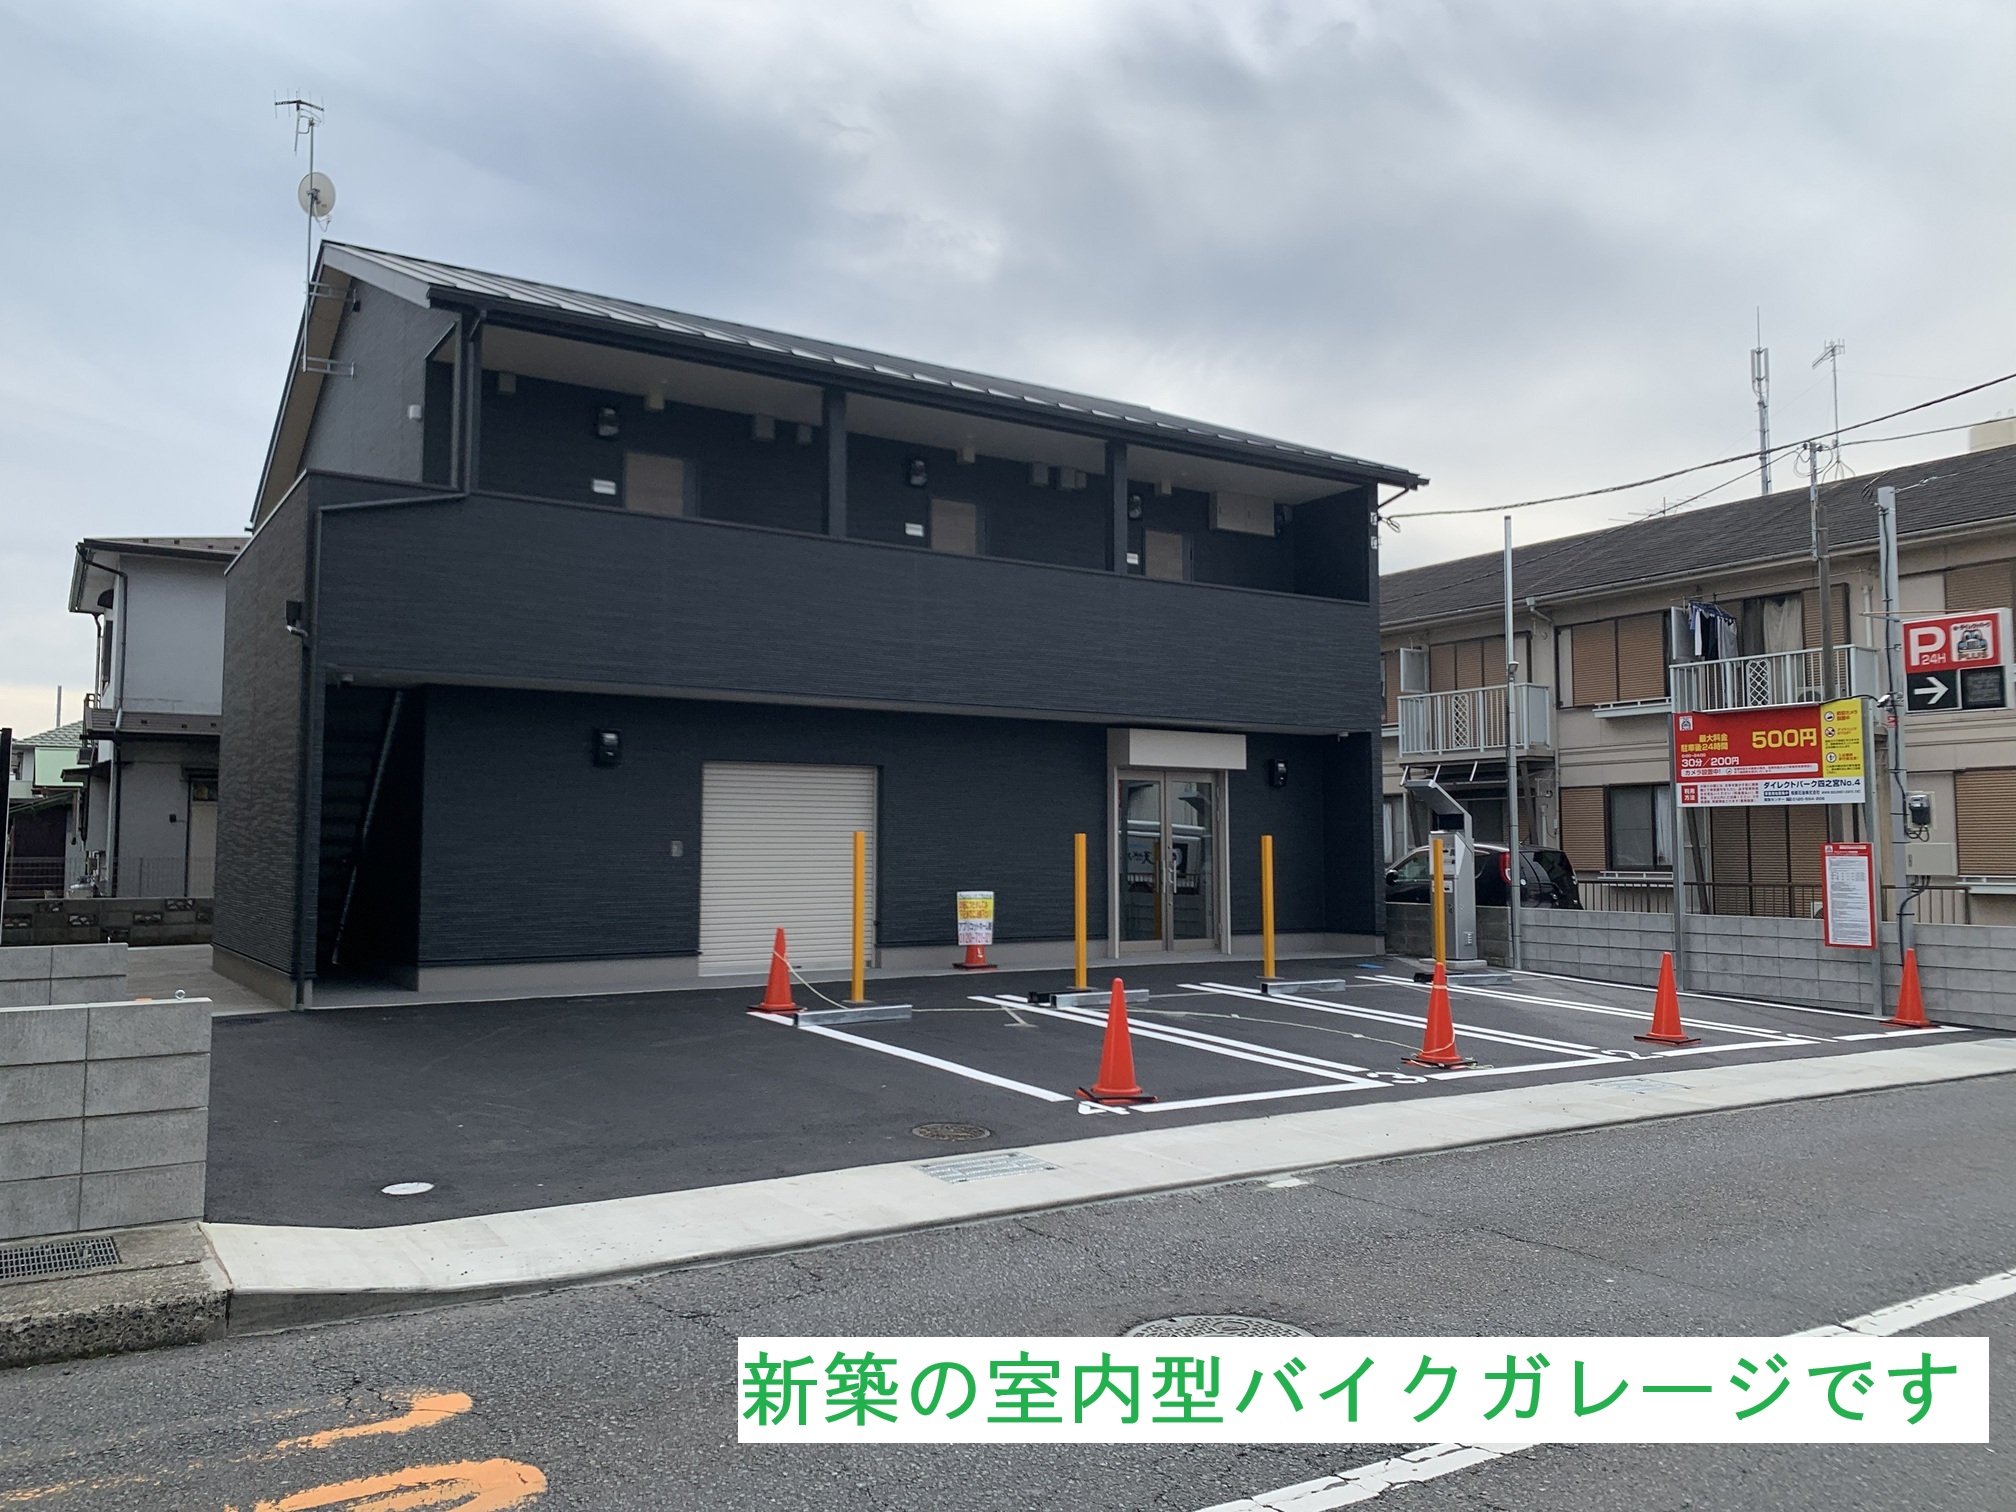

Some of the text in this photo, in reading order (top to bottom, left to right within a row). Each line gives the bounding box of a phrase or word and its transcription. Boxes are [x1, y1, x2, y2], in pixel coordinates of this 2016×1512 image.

[1909, 626, 1946, 667] P
[1921, 653, 1946, 666] 24H
[1958, 651, 1988, 660] PLUS
[1699, 733, 1728, 743] 最大料金
[1752, 728, 1817, 749] 500円
[1681, 742, 1729, 753] 駐車後24時間
